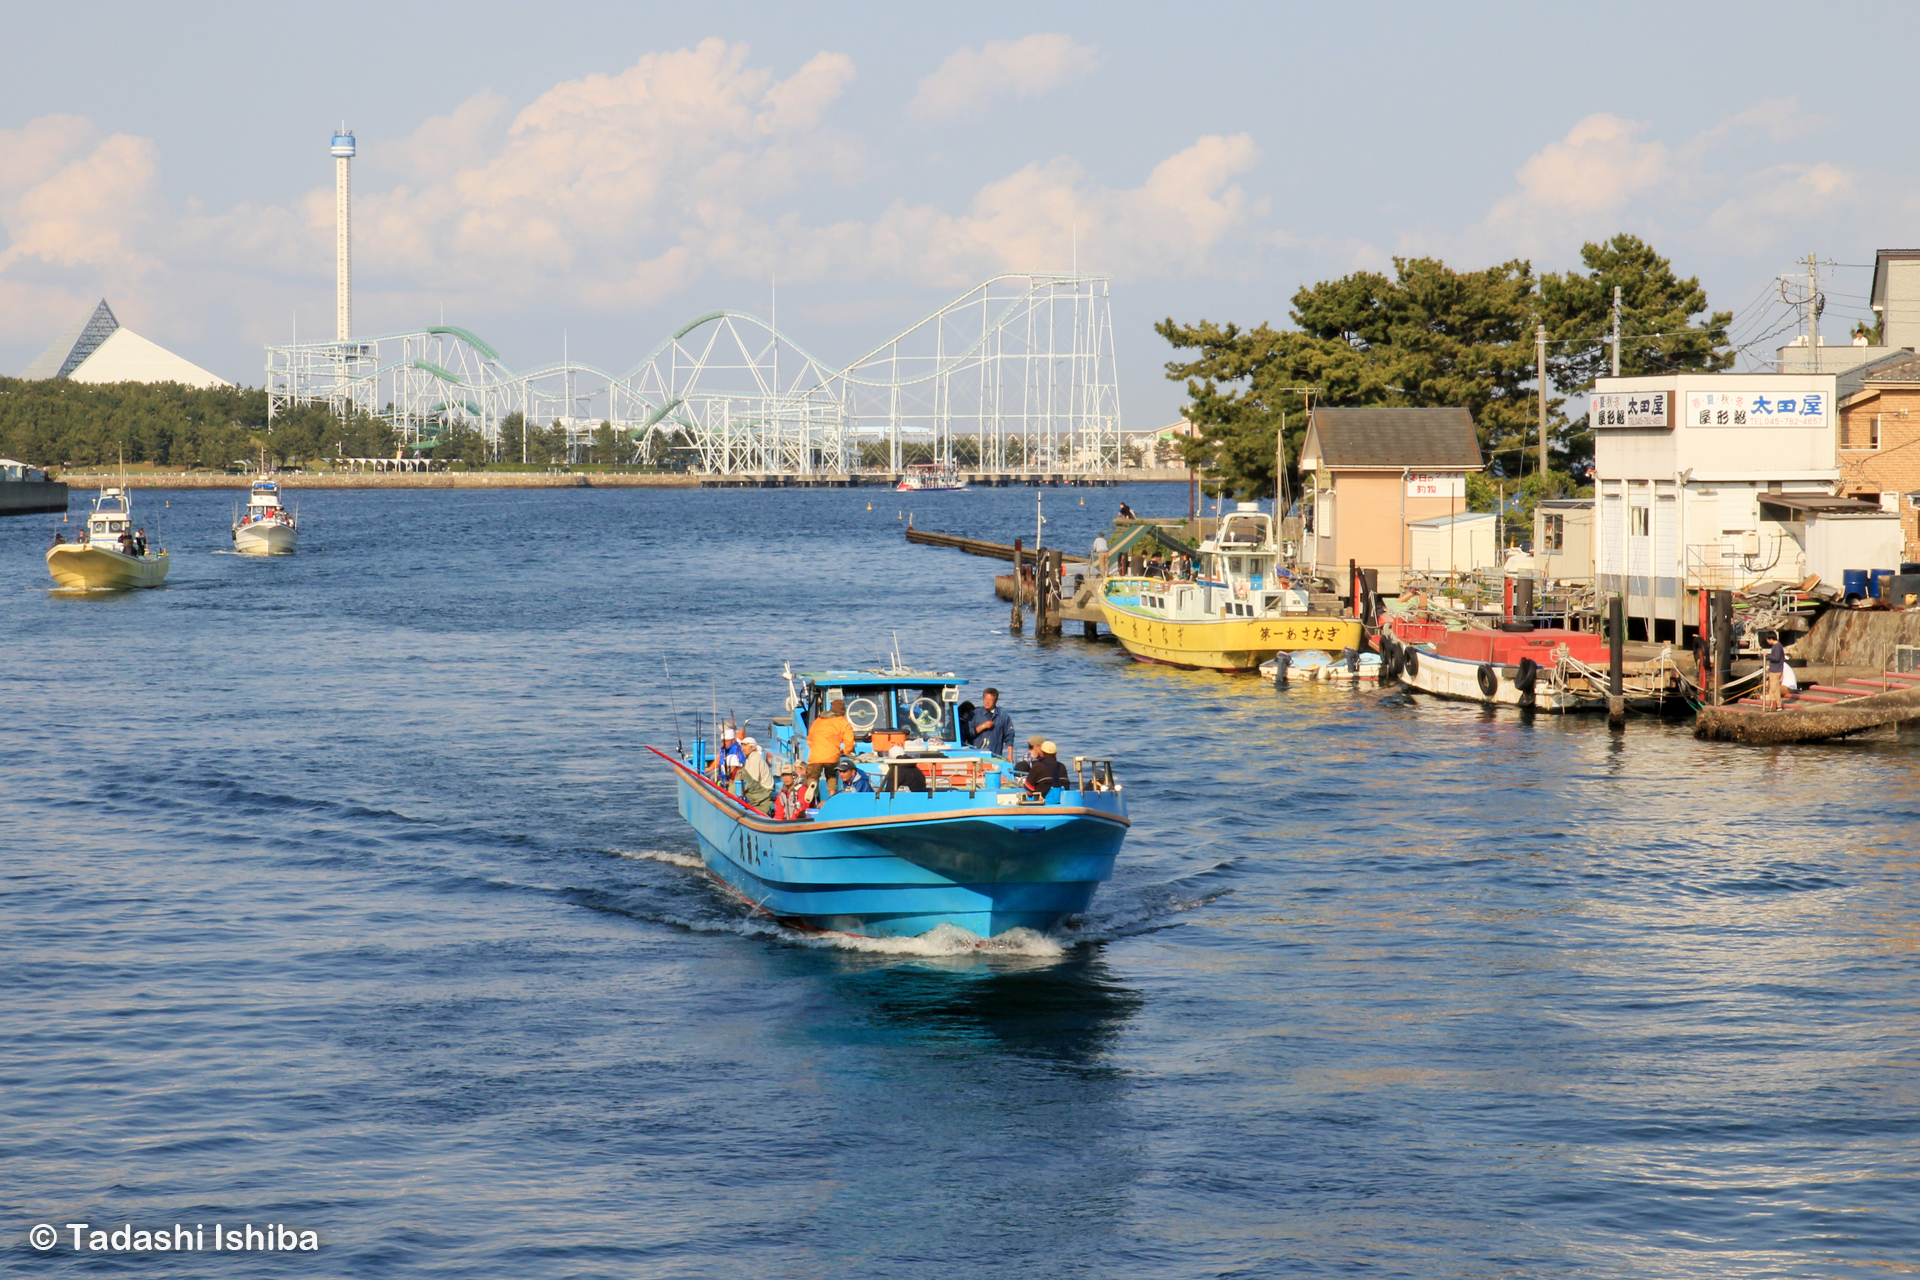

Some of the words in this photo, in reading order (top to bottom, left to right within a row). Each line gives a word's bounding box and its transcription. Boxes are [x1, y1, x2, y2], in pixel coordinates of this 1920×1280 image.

[1628, 394, 1664, 416] 太田屋
[1751, 395, 1823, 416] 太田屋
[1410, 473, 1434, 482] 本日の
[1260, 626, 1341, 642] 第一あさなぎ
